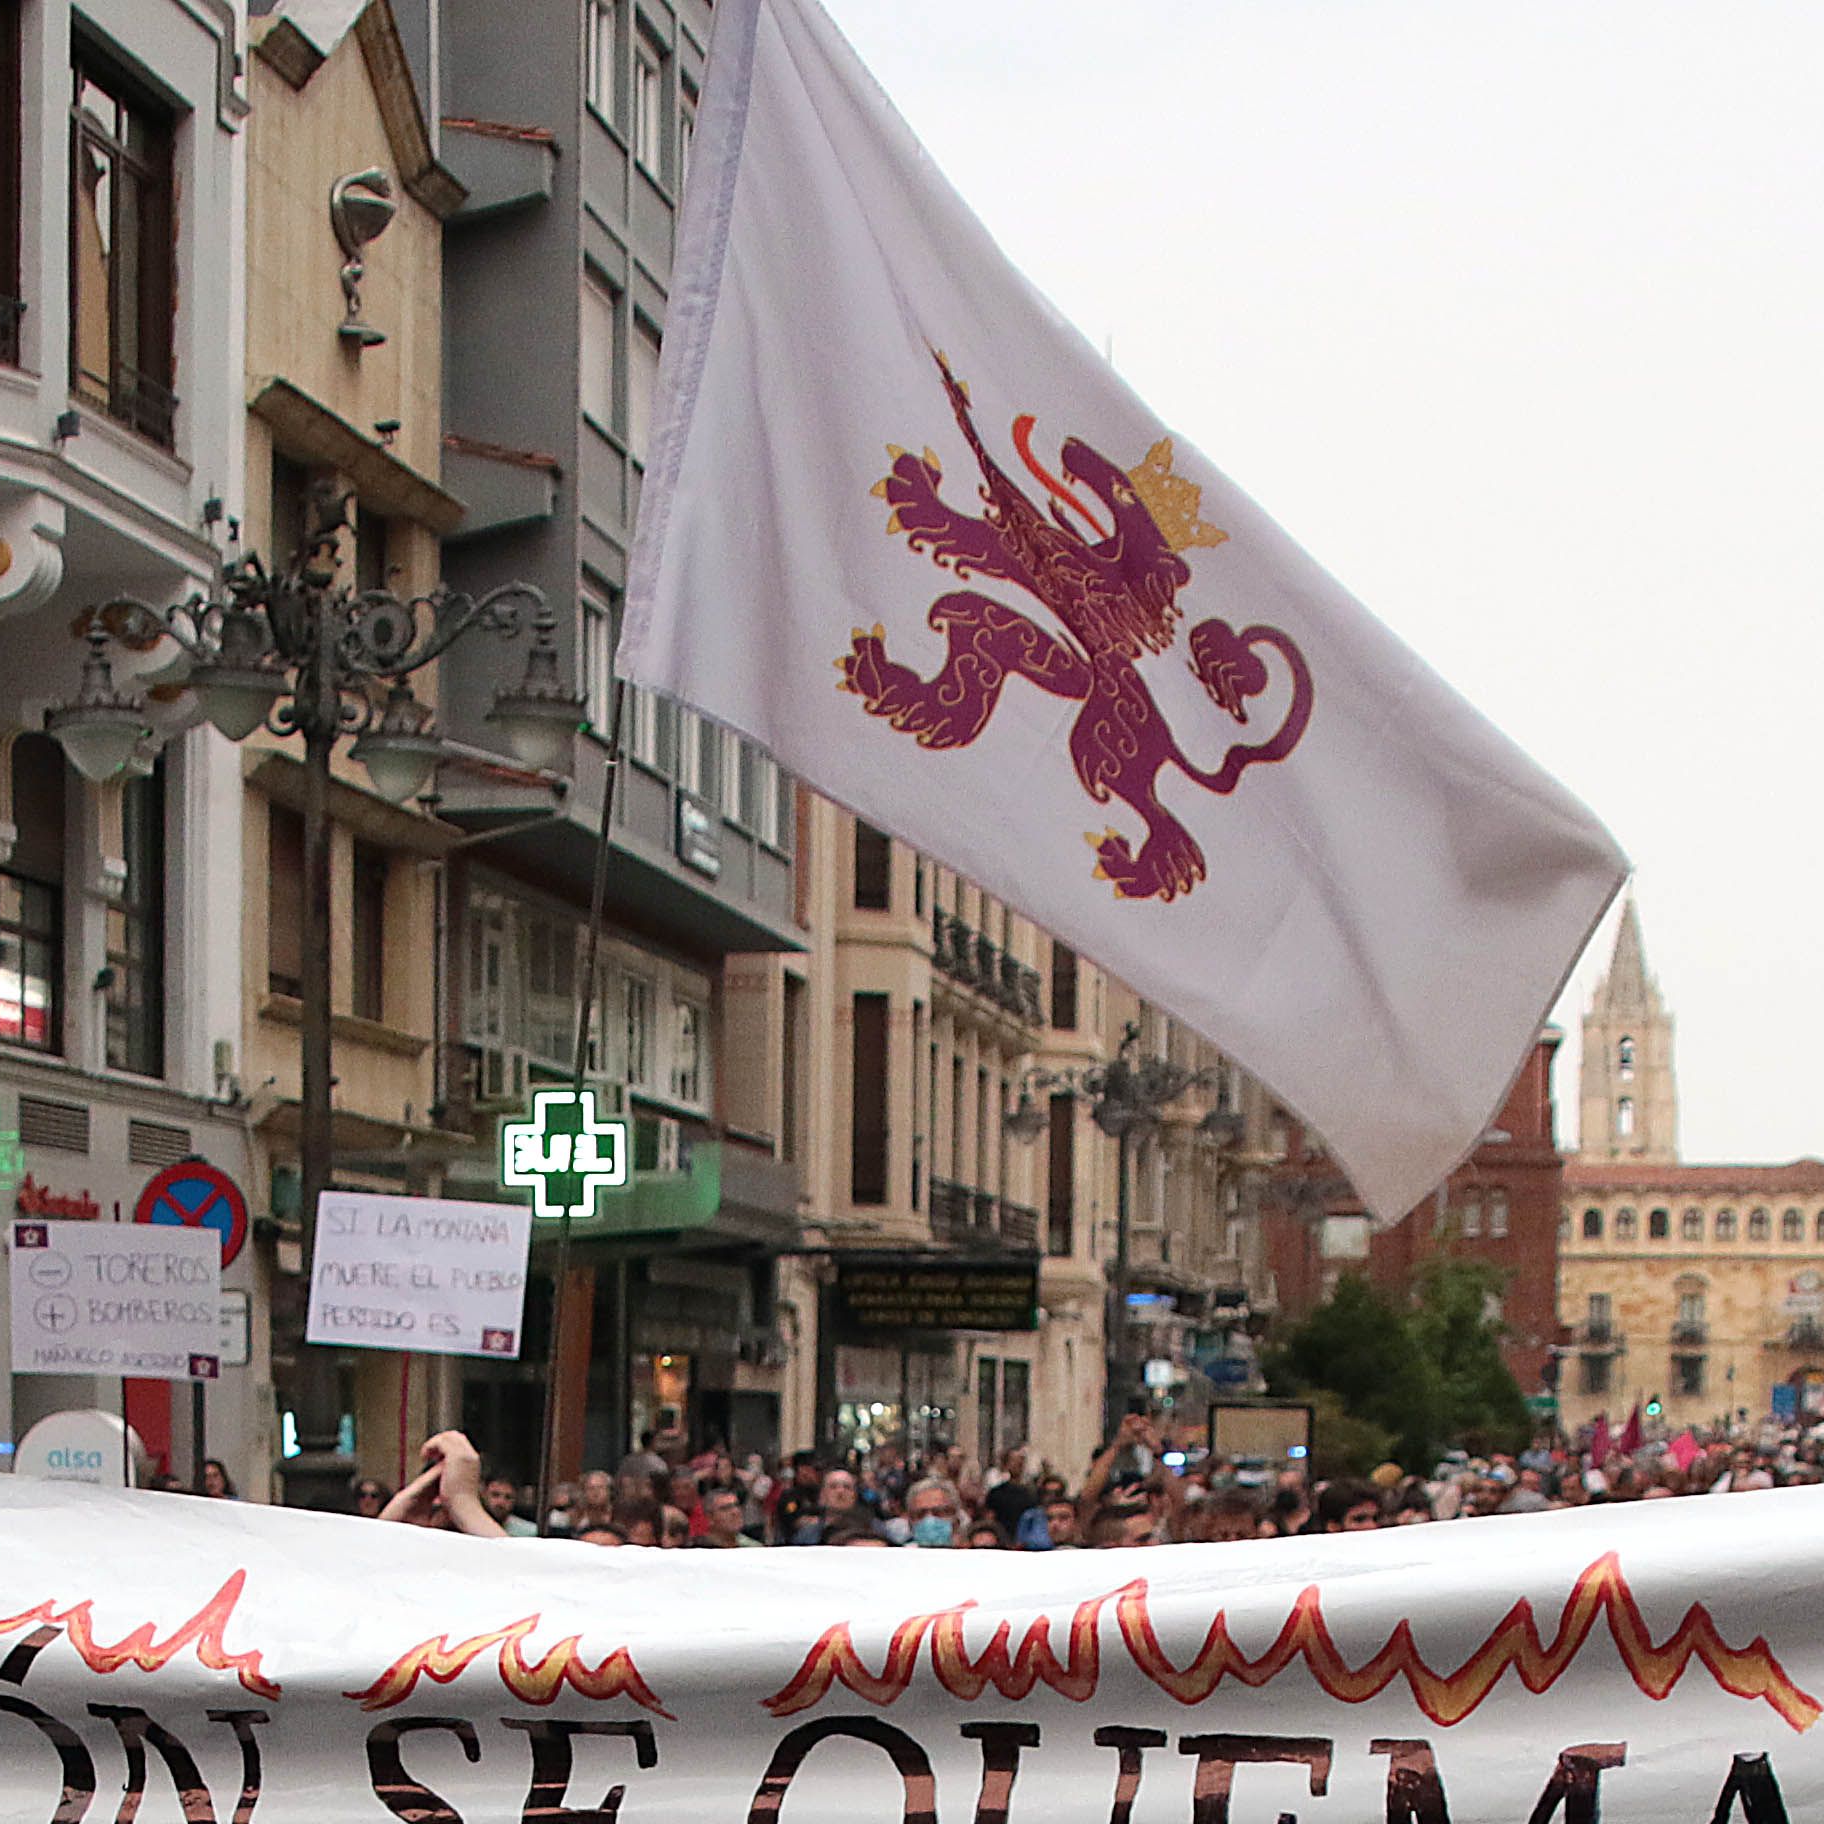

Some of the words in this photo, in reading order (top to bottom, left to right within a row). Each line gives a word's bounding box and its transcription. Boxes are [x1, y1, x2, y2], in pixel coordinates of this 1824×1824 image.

[377, 1212, 411, 1236] LA
[85, 1252, 211, 1285] TOREROS
[318, 1262, 400, 1289] MUERE
[411, 1264, 440, 1289] EL
[89, 1298, 212, 1324] BOMBEROS
[47, 1447, 102, 1469] alsa
